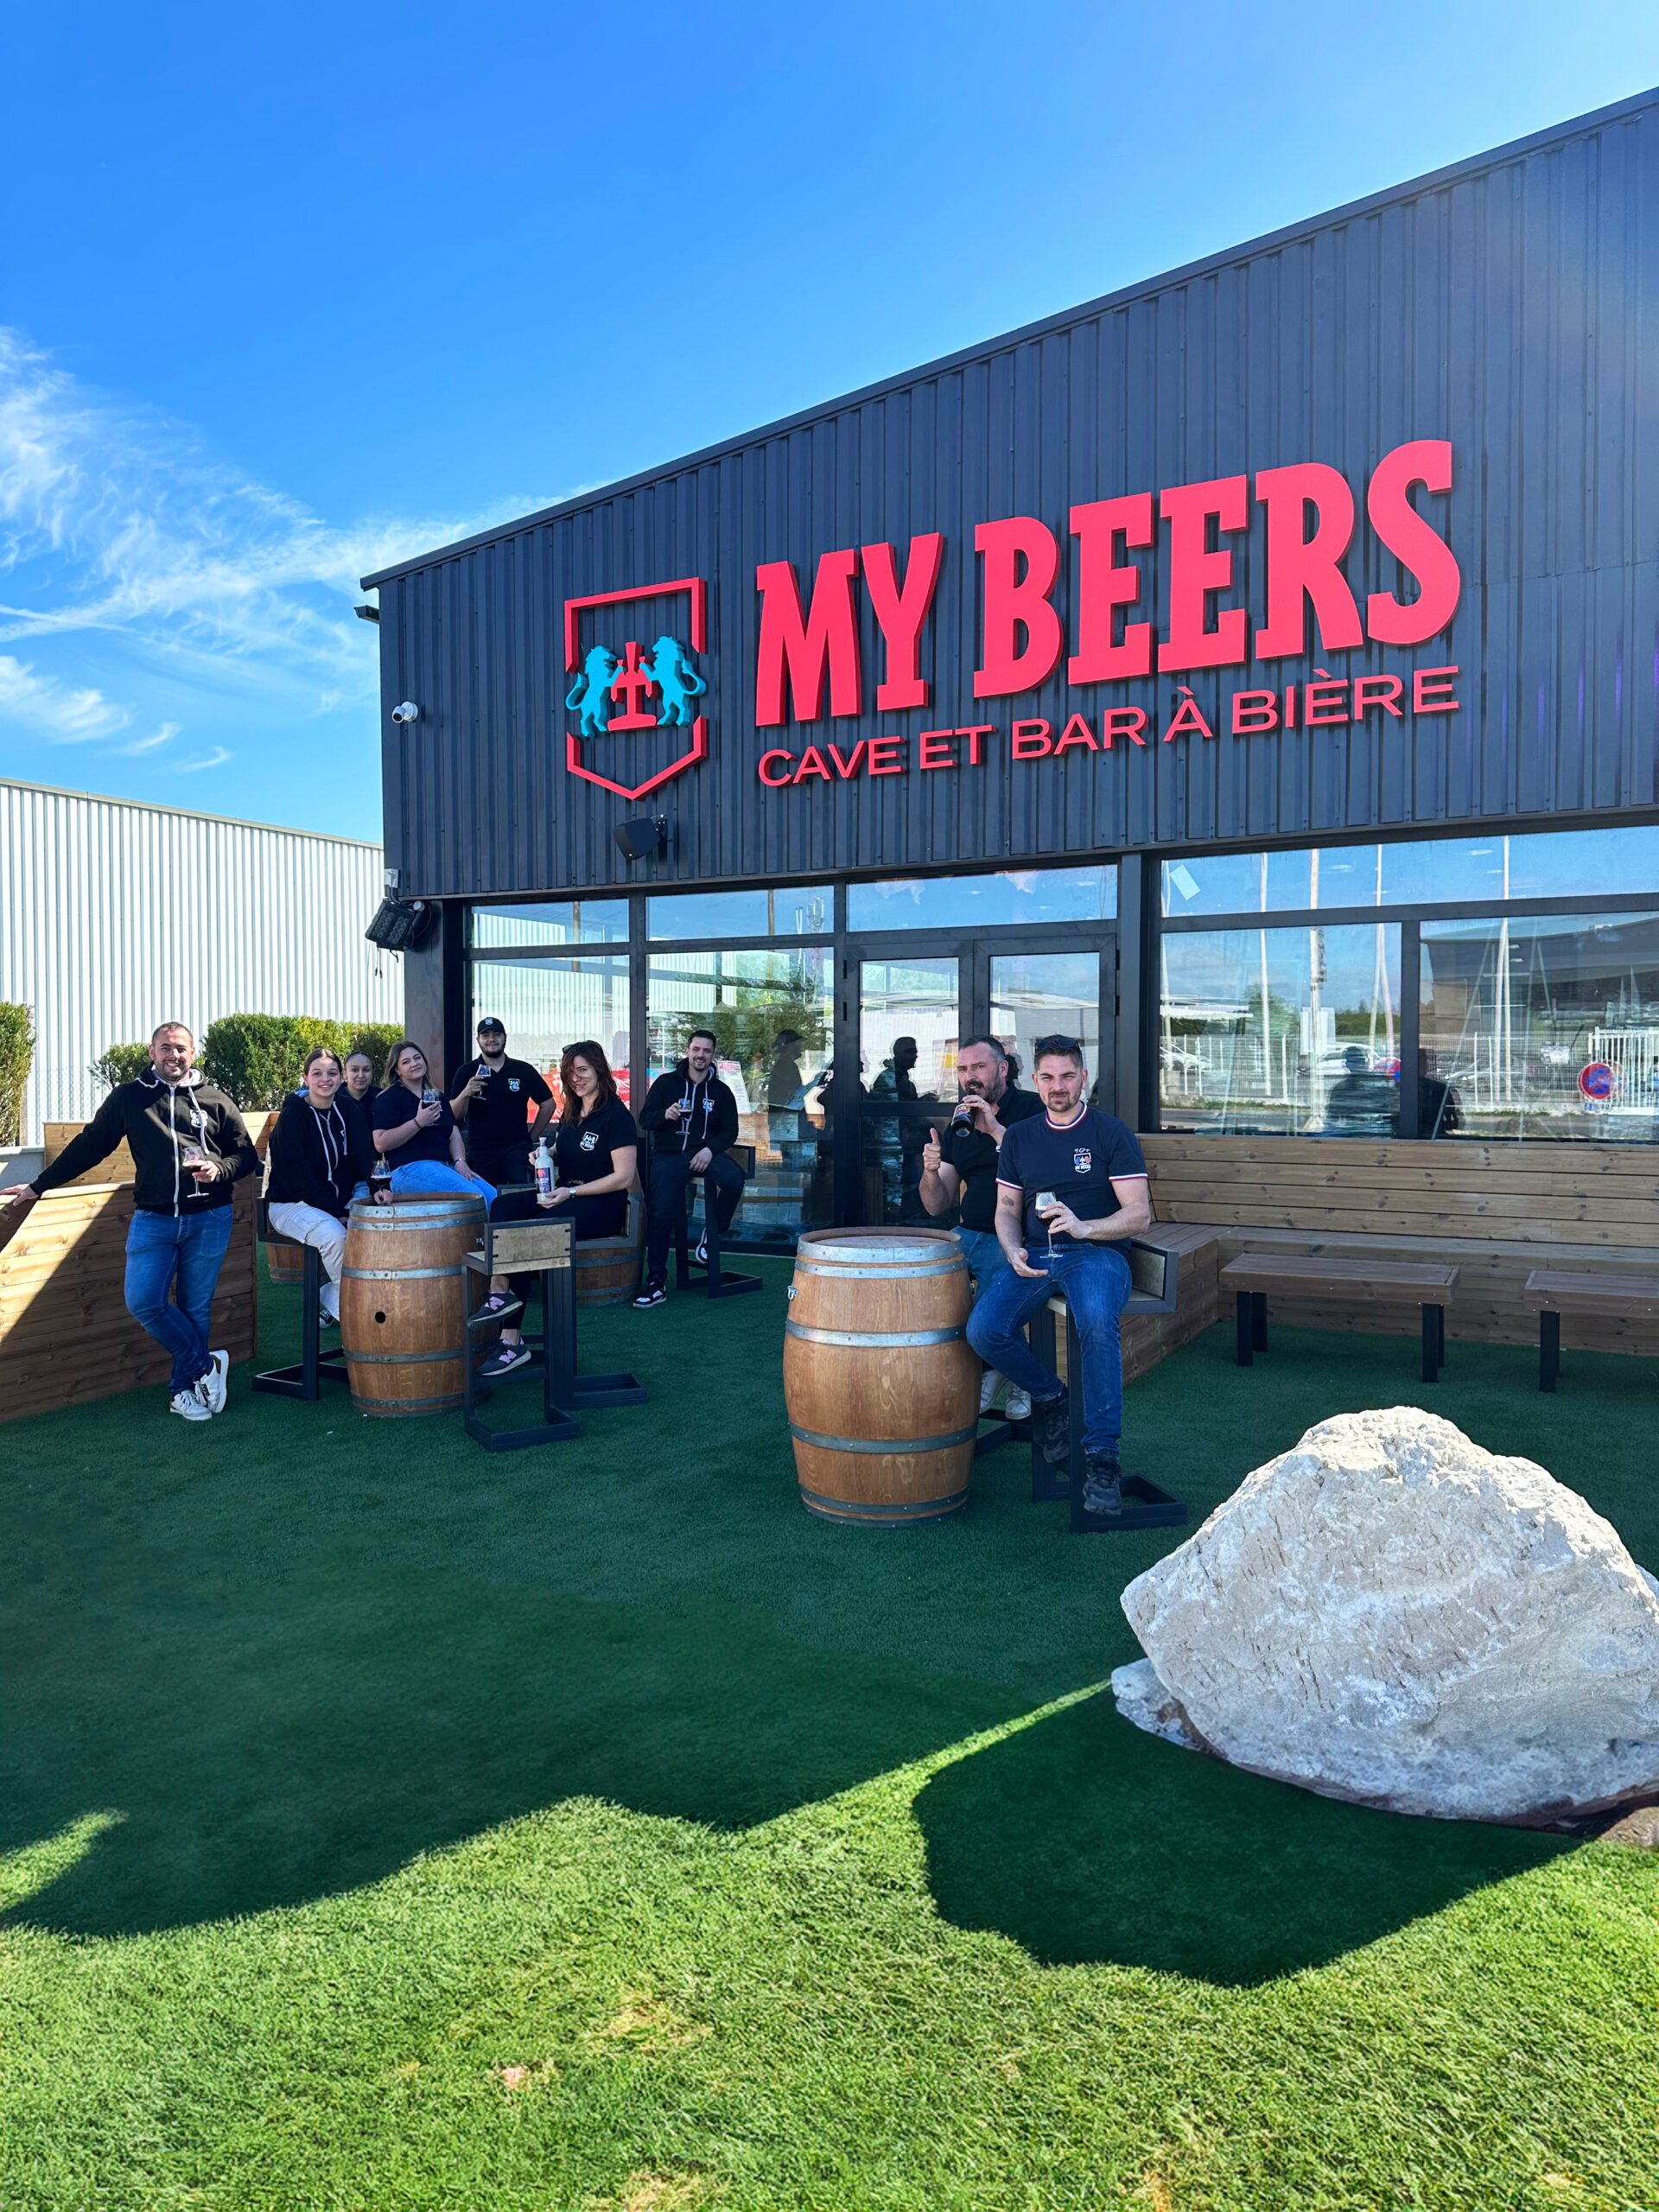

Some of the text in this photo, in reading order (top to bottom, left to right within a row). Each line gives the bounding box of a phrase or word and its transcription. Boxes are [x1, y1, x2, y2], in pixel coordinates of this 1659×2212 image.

[755, 440, 1462, 727] MY BEERS
[758, 665, 1460, 787] CAVE ET BAR À BIÈRE
